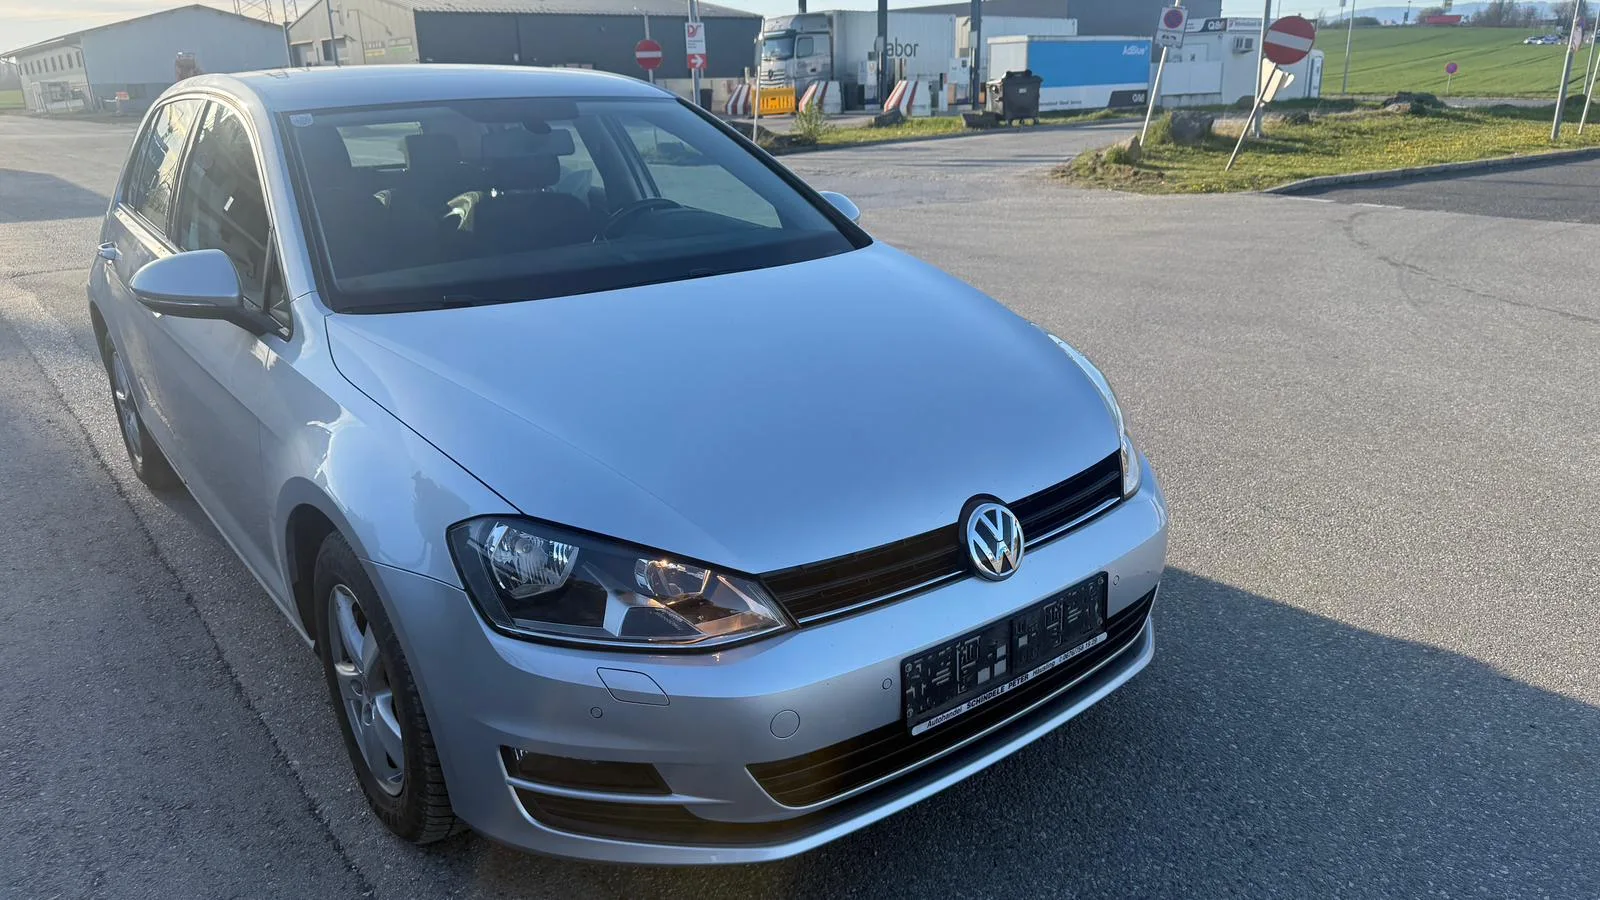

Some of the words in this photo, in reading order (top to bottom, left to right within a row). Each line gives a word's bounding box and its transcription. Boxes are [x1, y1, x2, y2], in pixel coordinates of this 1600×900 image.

[968, 505, 1022, 575] VW
[966, 686, 1005, 710] SCHINDELE
[1007, 673, 1029, 690] PETER
